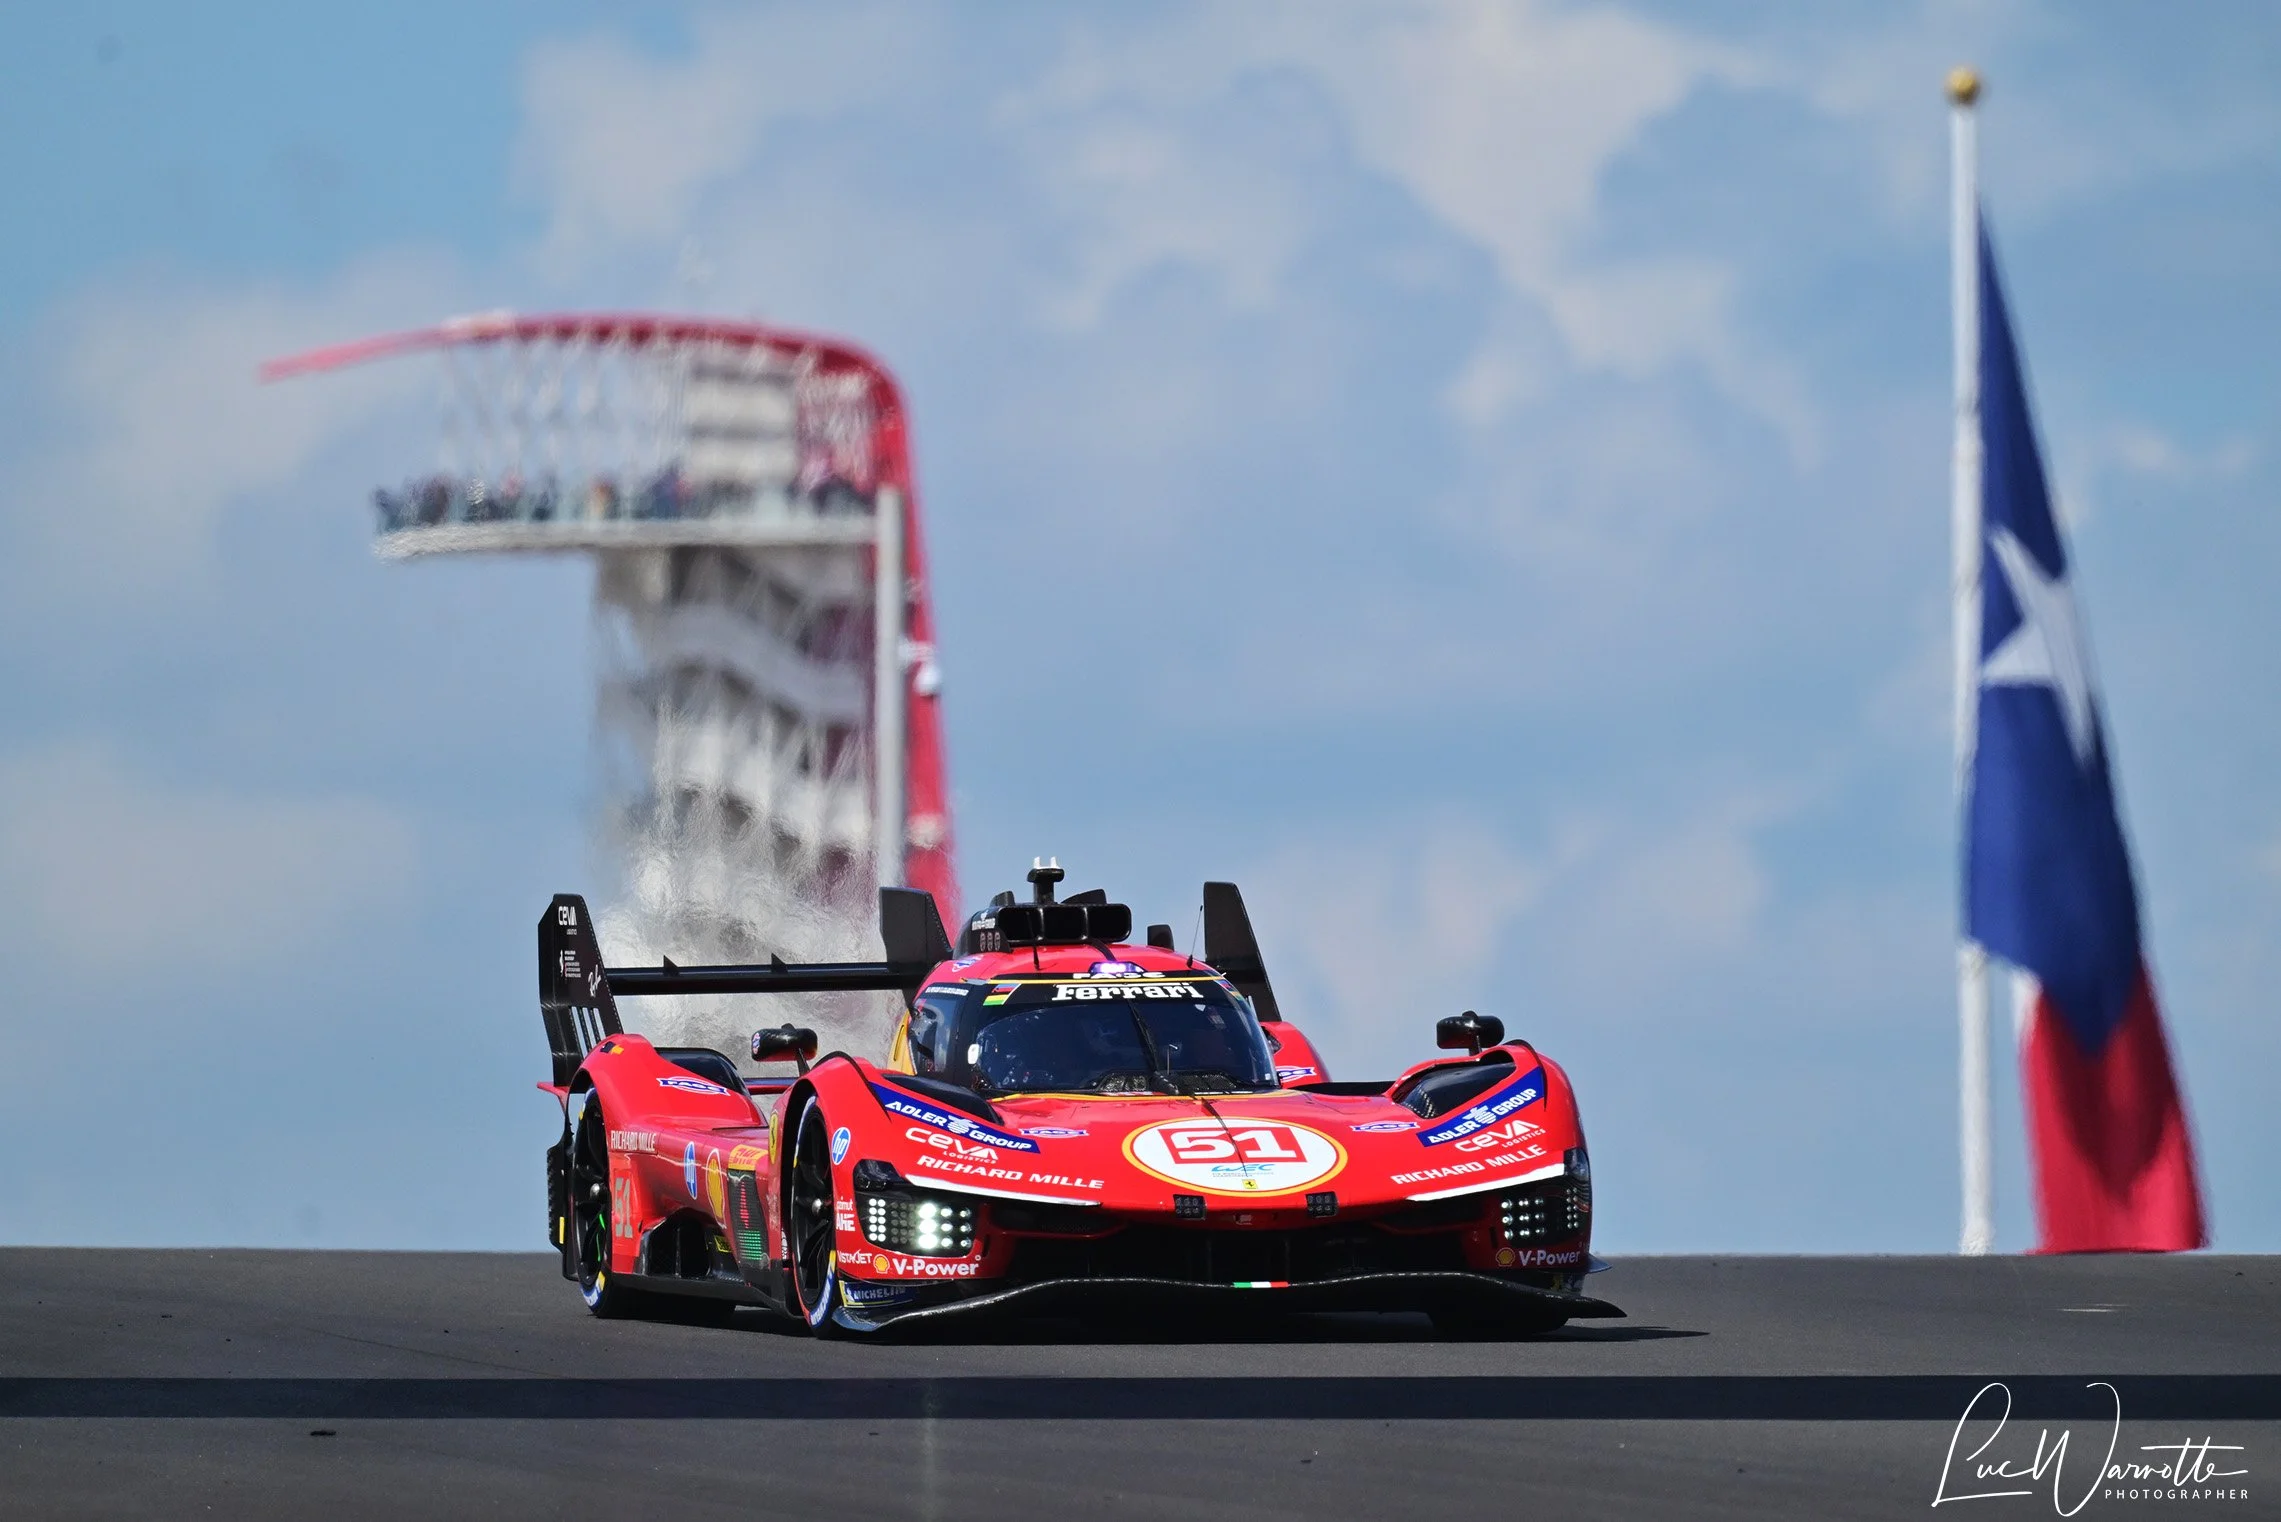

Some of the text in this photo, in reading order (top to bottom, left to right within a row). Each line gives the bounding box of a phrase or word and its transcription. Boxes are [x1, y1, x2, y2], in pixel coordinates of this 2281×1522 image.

[1052, 982, 1204, 1001] Ferrari
[885, 1101, 1032, 1149] ADLER GROUP
[1428, 1088, 1537, 1144] ADLER GROUP
[611, 1130, 657, 1152] RICHARD MILLE
[832, 1128, 849, 1163] hp
[1170, 1129, 1297, 1159] 51
[1502, 1128, 1546, 1148] LOGISTICS
[917, 1155, 1105, 1189] RICHARD MILLE
[943, 1151, 996, 1164] LOGISTICS
[1391, 1144, 1547, 1185] RICHARD MILLE
[615, 1177, 633, 1239] 51
[893, 1258, 979, 1276] V-Power
[1519, 1250, 1580, 1266] V-Power
